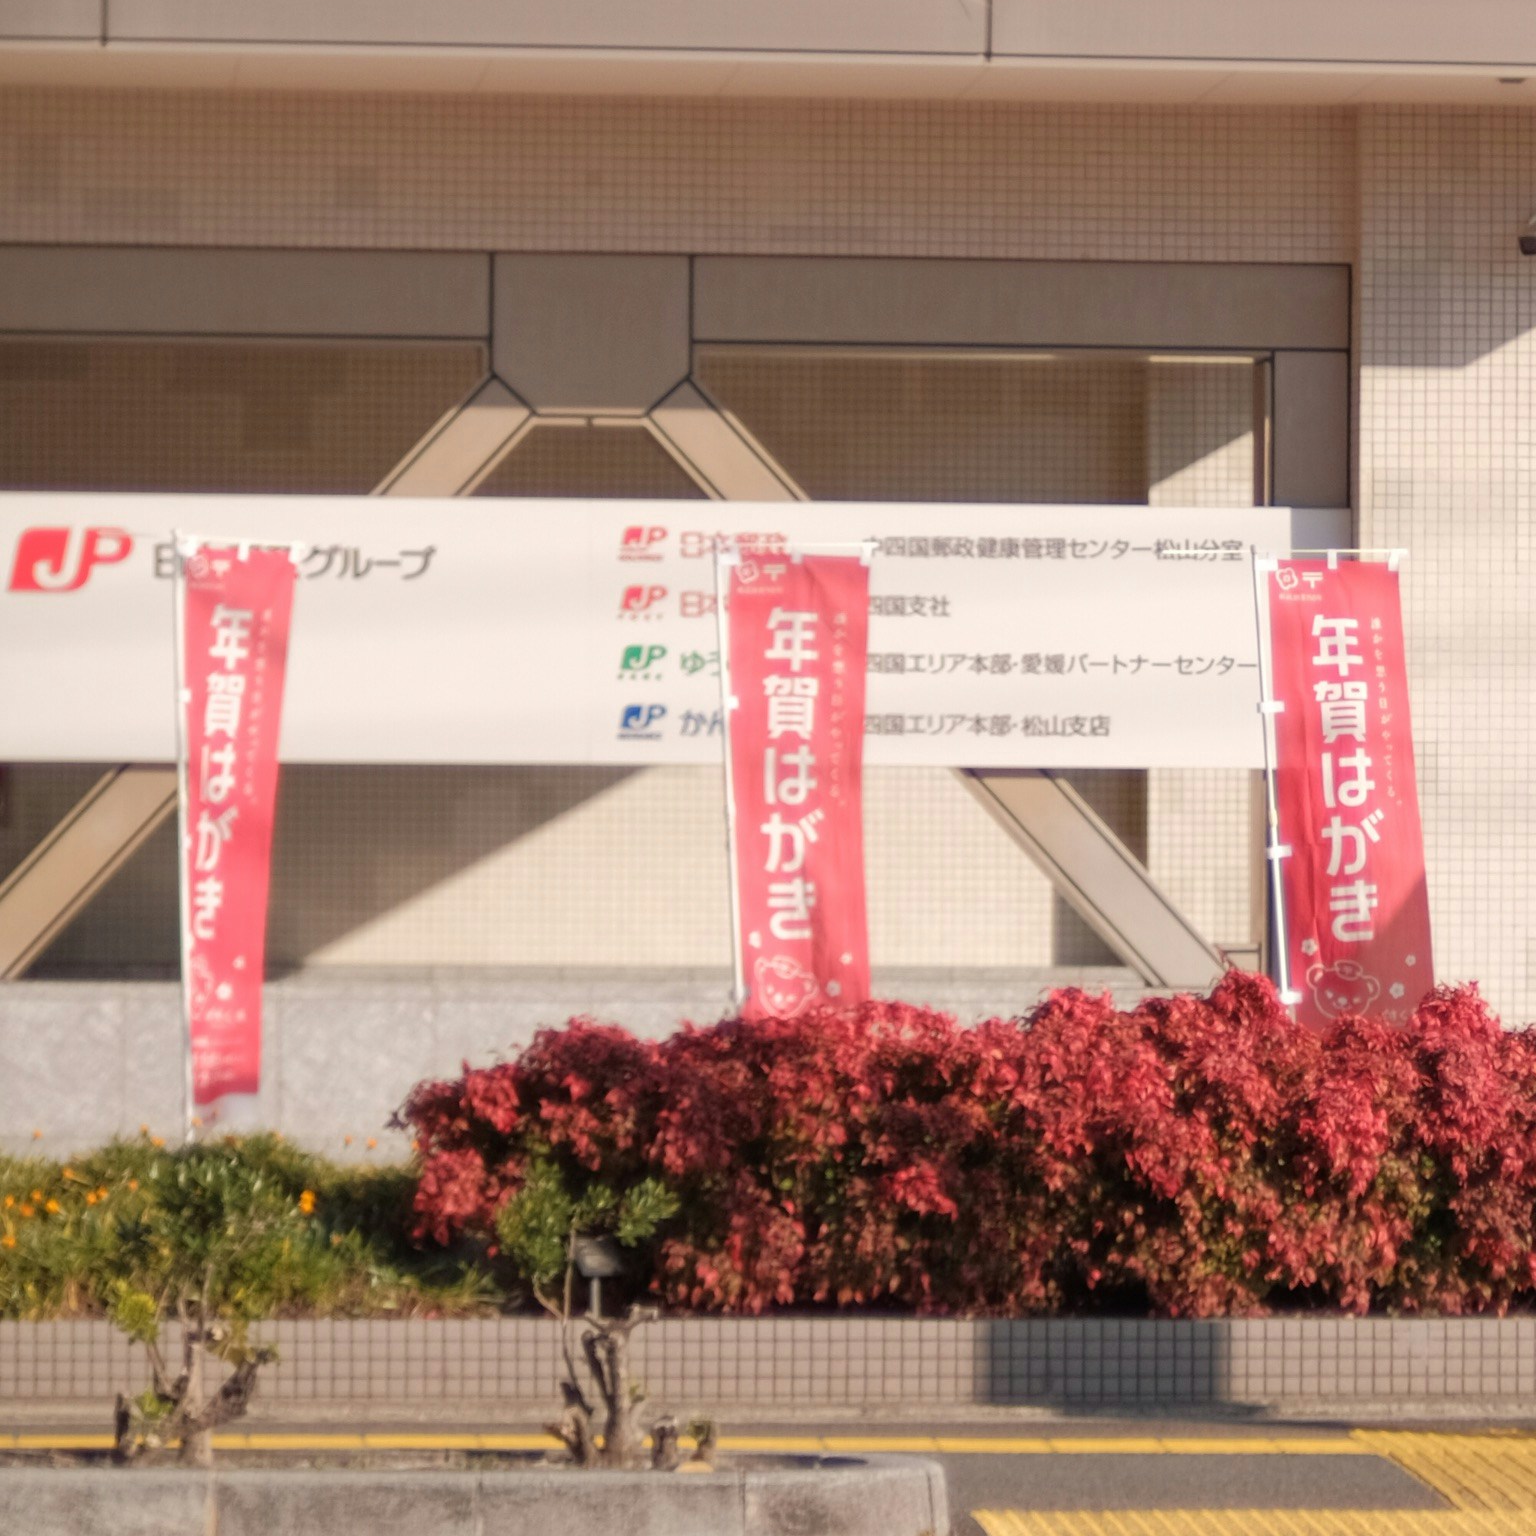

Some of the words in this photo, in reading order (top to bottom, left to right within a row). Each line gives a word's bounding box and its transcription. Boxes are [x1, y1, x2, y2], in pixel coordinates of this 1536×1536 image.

[7, 526, 134, 593] JP
[620, 525, 668, 548] JP
[619, 585, 668, 612] JP
[619, 644, 668, 670] JP
[619, 704, 668, 730] JP
[195, 604, 254, 940] 年賀はがき
[762, 606, 825, 941] 年賀はがき
[1311, 614, 1387, 943] 年賀はがき
